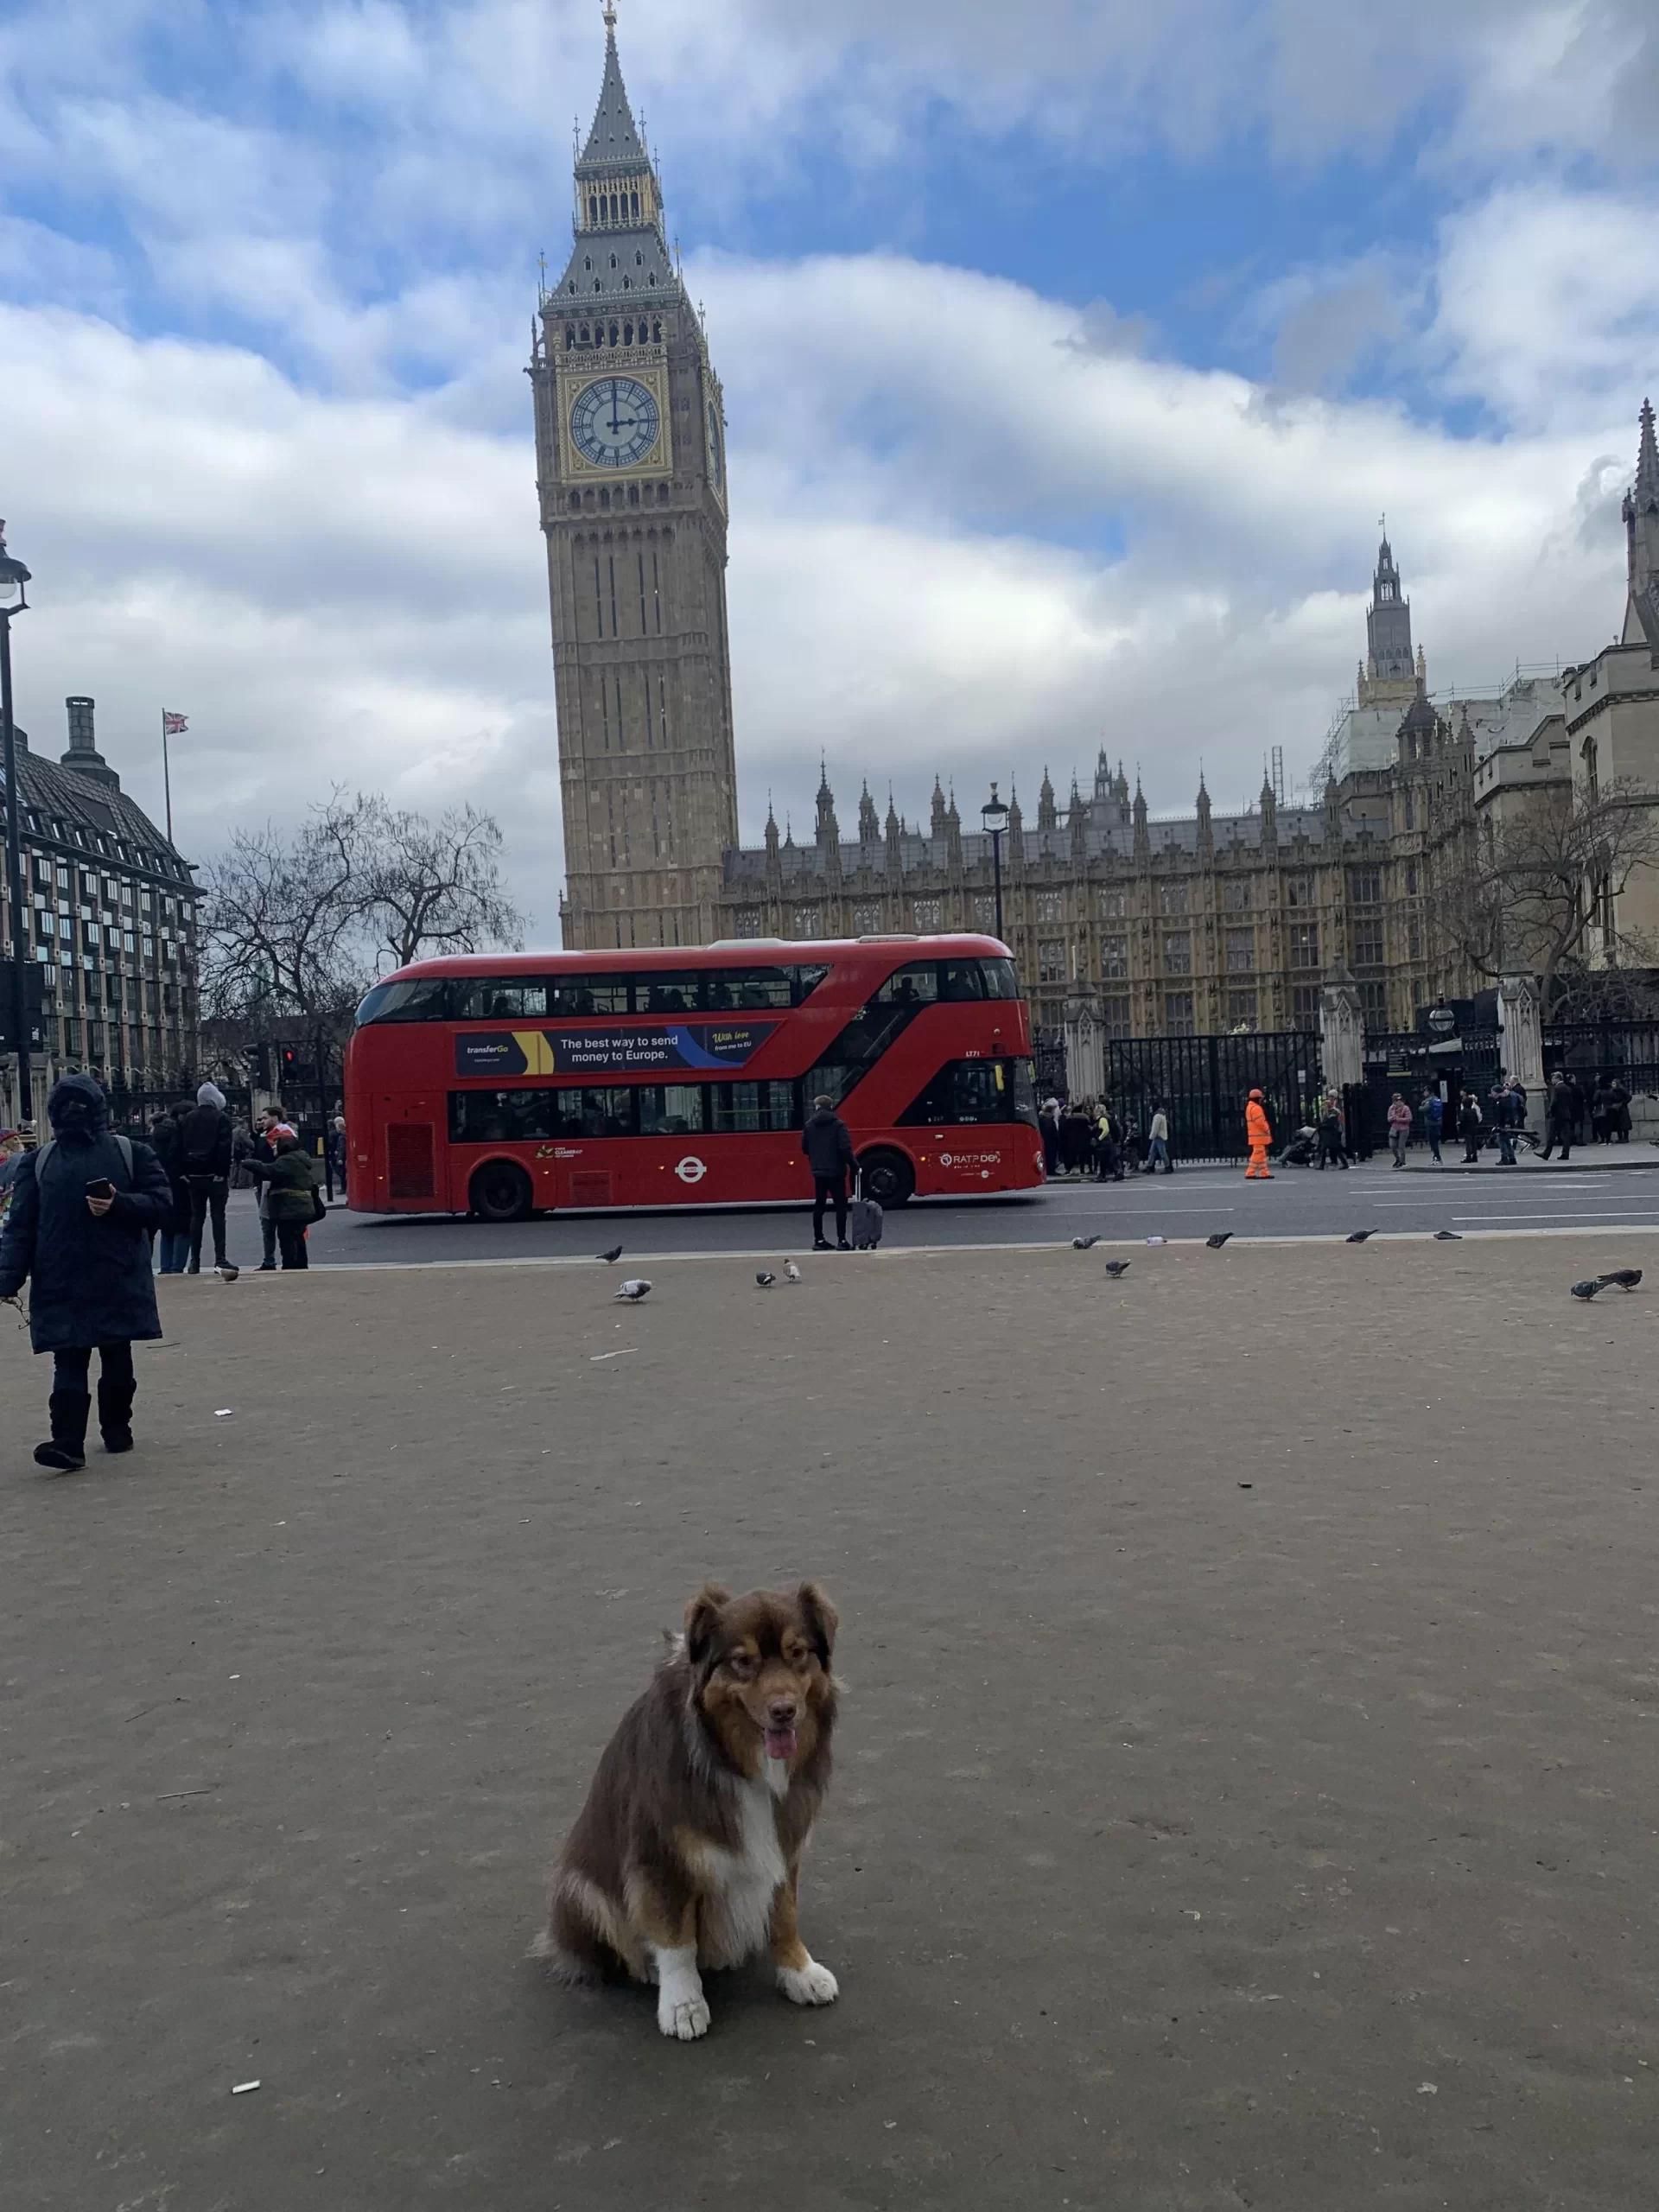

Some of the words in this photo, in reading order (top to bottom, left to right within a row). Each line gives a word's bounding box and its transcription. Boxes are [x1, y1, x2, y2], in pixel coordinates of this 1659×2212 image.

[561, 1039, 582, 1049] The
[585, 1039, 609, 1048] best
[612, 1037, 634, 1048] way
[638, 1037, 649, 1046] to
[652, 1035, 678, 1046] send
[711, 1032, 733, 1043] With
[467, 1045, 509, 1054] transferGo
[572, 1052, 609, 1063] money
[612, 1052, 623, 1060] to
[626, 1050, 669, 1061] Europe.
